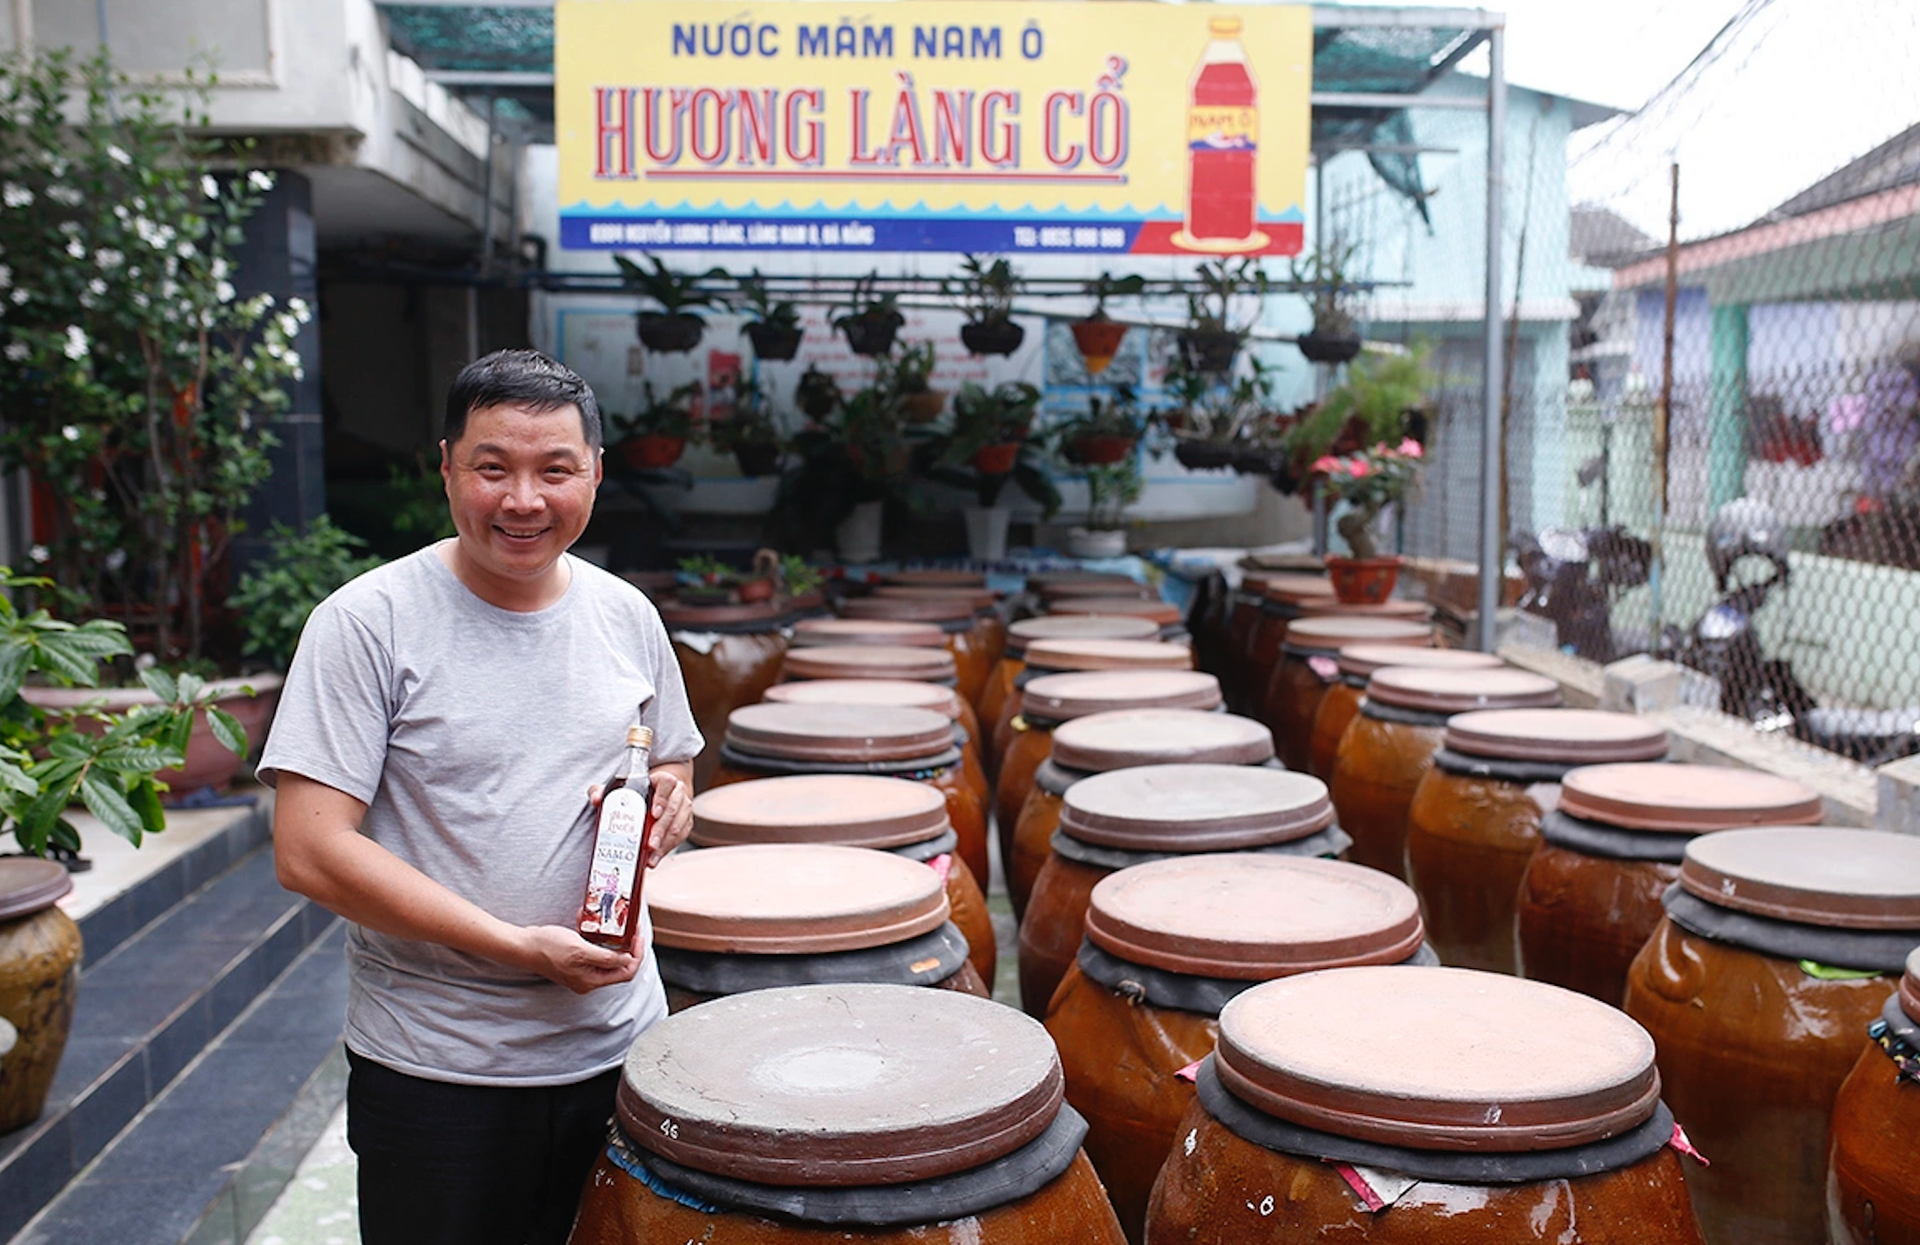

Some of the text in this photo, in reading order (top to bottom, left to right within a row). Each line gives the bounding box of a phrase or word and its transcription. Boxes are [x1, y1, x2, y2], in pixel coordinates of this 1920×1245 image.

[798, 16, 893, 57] MẮM
[914, 26, 1000, 58] NAM
[1022, 20, 1043, 59] Ô
[593, 56, 1129, 179] HƯƠNG LÀNG CỔ
